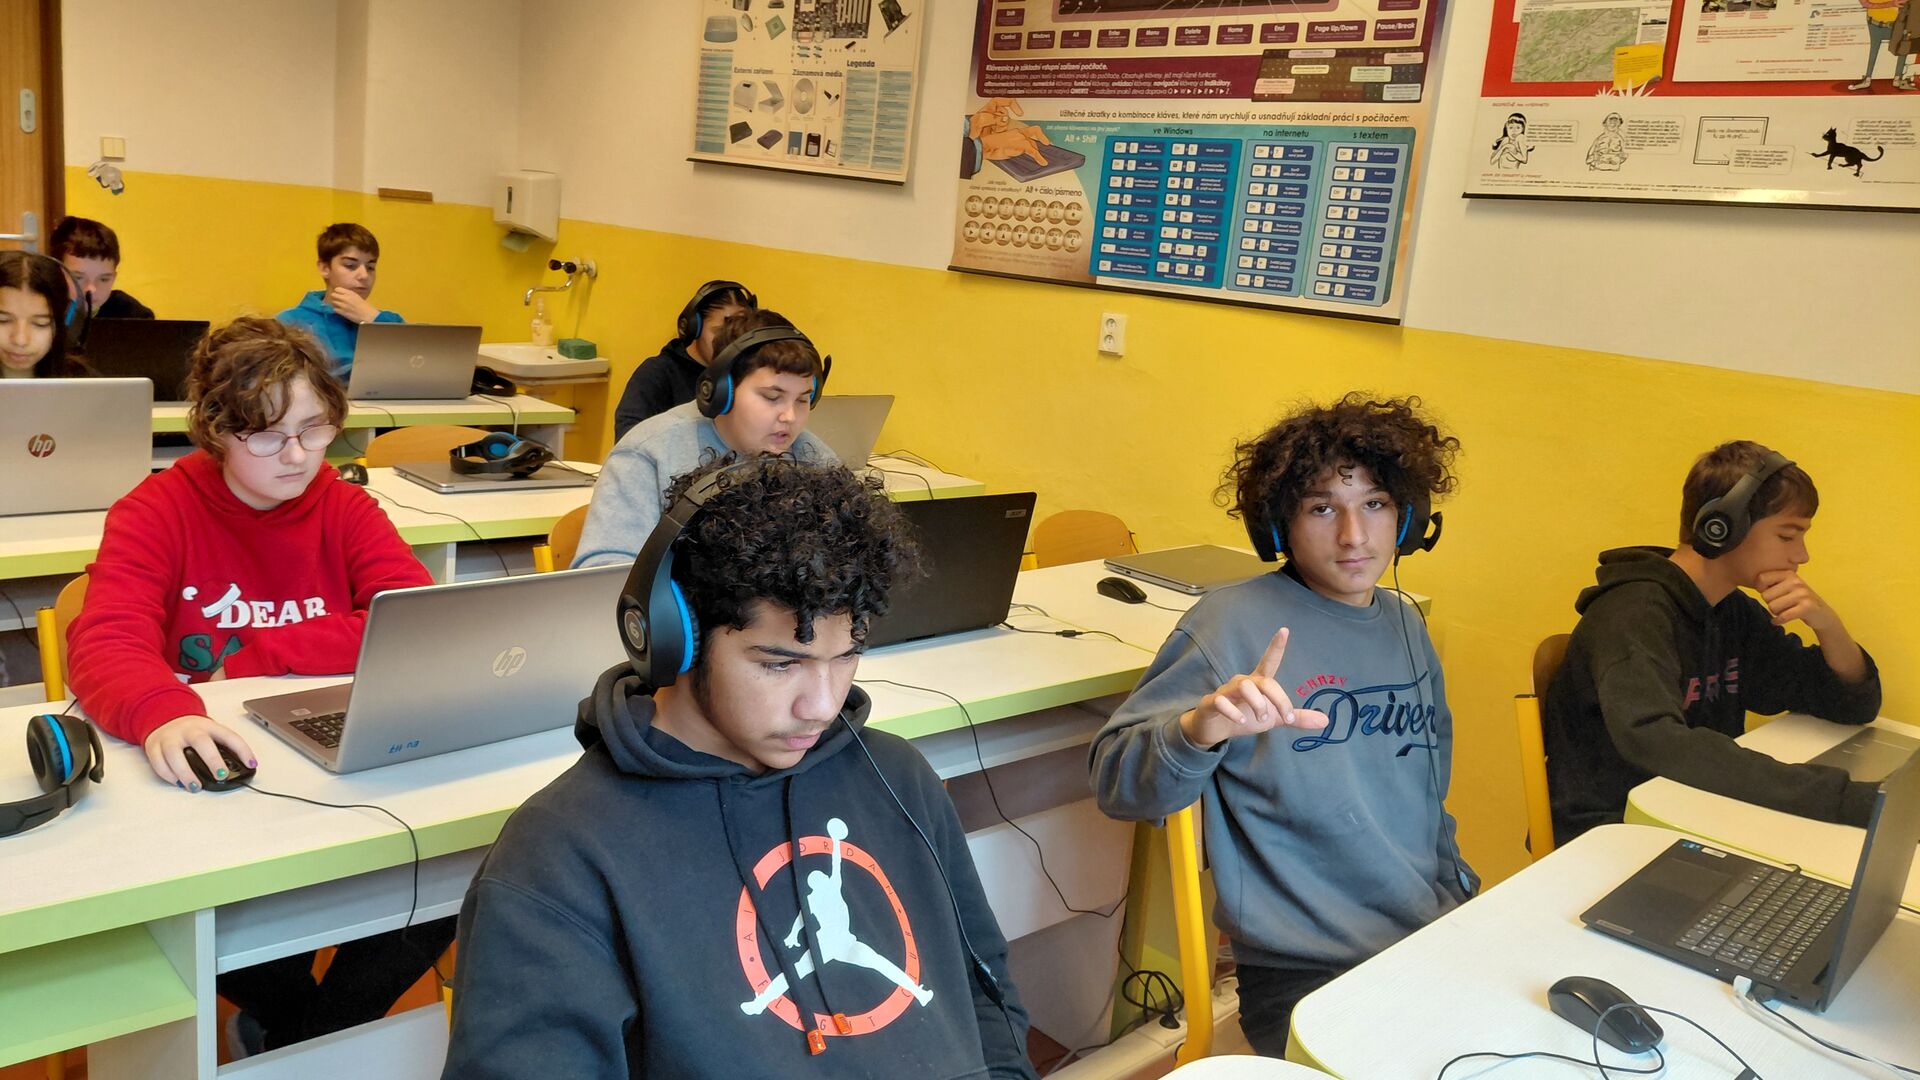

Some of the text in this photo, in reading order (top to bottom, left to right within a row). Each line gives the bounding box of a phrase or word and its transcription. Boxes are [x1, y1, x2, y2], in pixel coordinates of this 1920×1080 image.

[1314, 25, 1330, 33] Page
[847, 60, 875, 68] Legenda
[1059, 109, 1085, 118] Užitečné
[1087, 110, 1111, 119] zkratky
[1118, 110, 1155, 119] kombinace
[1156, 111, 1180, 120] kláves,
[1182, 111, 1200, 119] které
[1201, 111, 1218, 119] nám
[1219, 111, 1250, 121] urychlují
[1258, 112, 1295, 122] usnadňují
[1297, 112, 1331, 121] základní
[1332, 113, 1355, 123] práci
[1362, 113, 1409, 123] počítačem:
[1163, 127, 1193, 135] Windows
[1275, 129, 1309, 137] internetu
[1064, 134, 1074, 142] Alt
[1082, 135, 1097, 143] Shift
[28, 433, 56, 458] hp
[492, 646, 527, 678] hp
[1292, 684, 1437, 752] Driver
